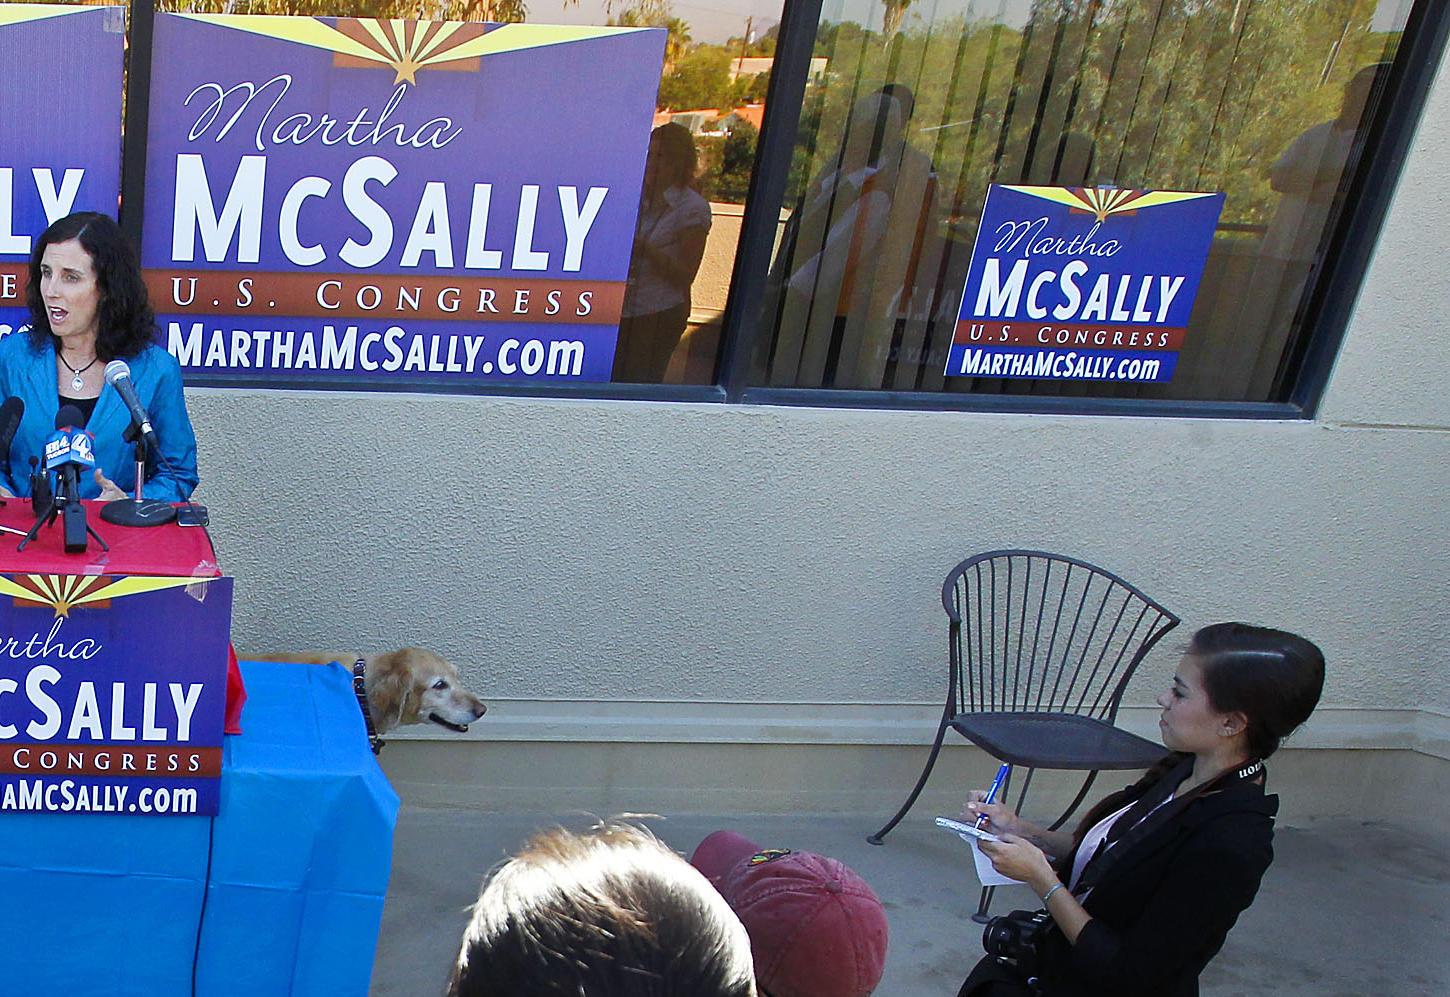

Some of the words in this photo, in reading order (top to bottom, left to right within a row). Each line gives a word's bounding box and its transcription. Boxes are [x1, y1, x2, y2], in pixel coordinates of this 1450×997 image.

[183, 73, 463, 152] Martha
[993, 217, 1123, 258] Martha
[171, 277, 276, 308] U.S.
[316, 280, 594, 317] CONGRESS
[969, 324, 1020, 342] U.S.
[1037, 327, 1170, 347] CONGRESS
[13, 748, 201, 772] CONGRESS
